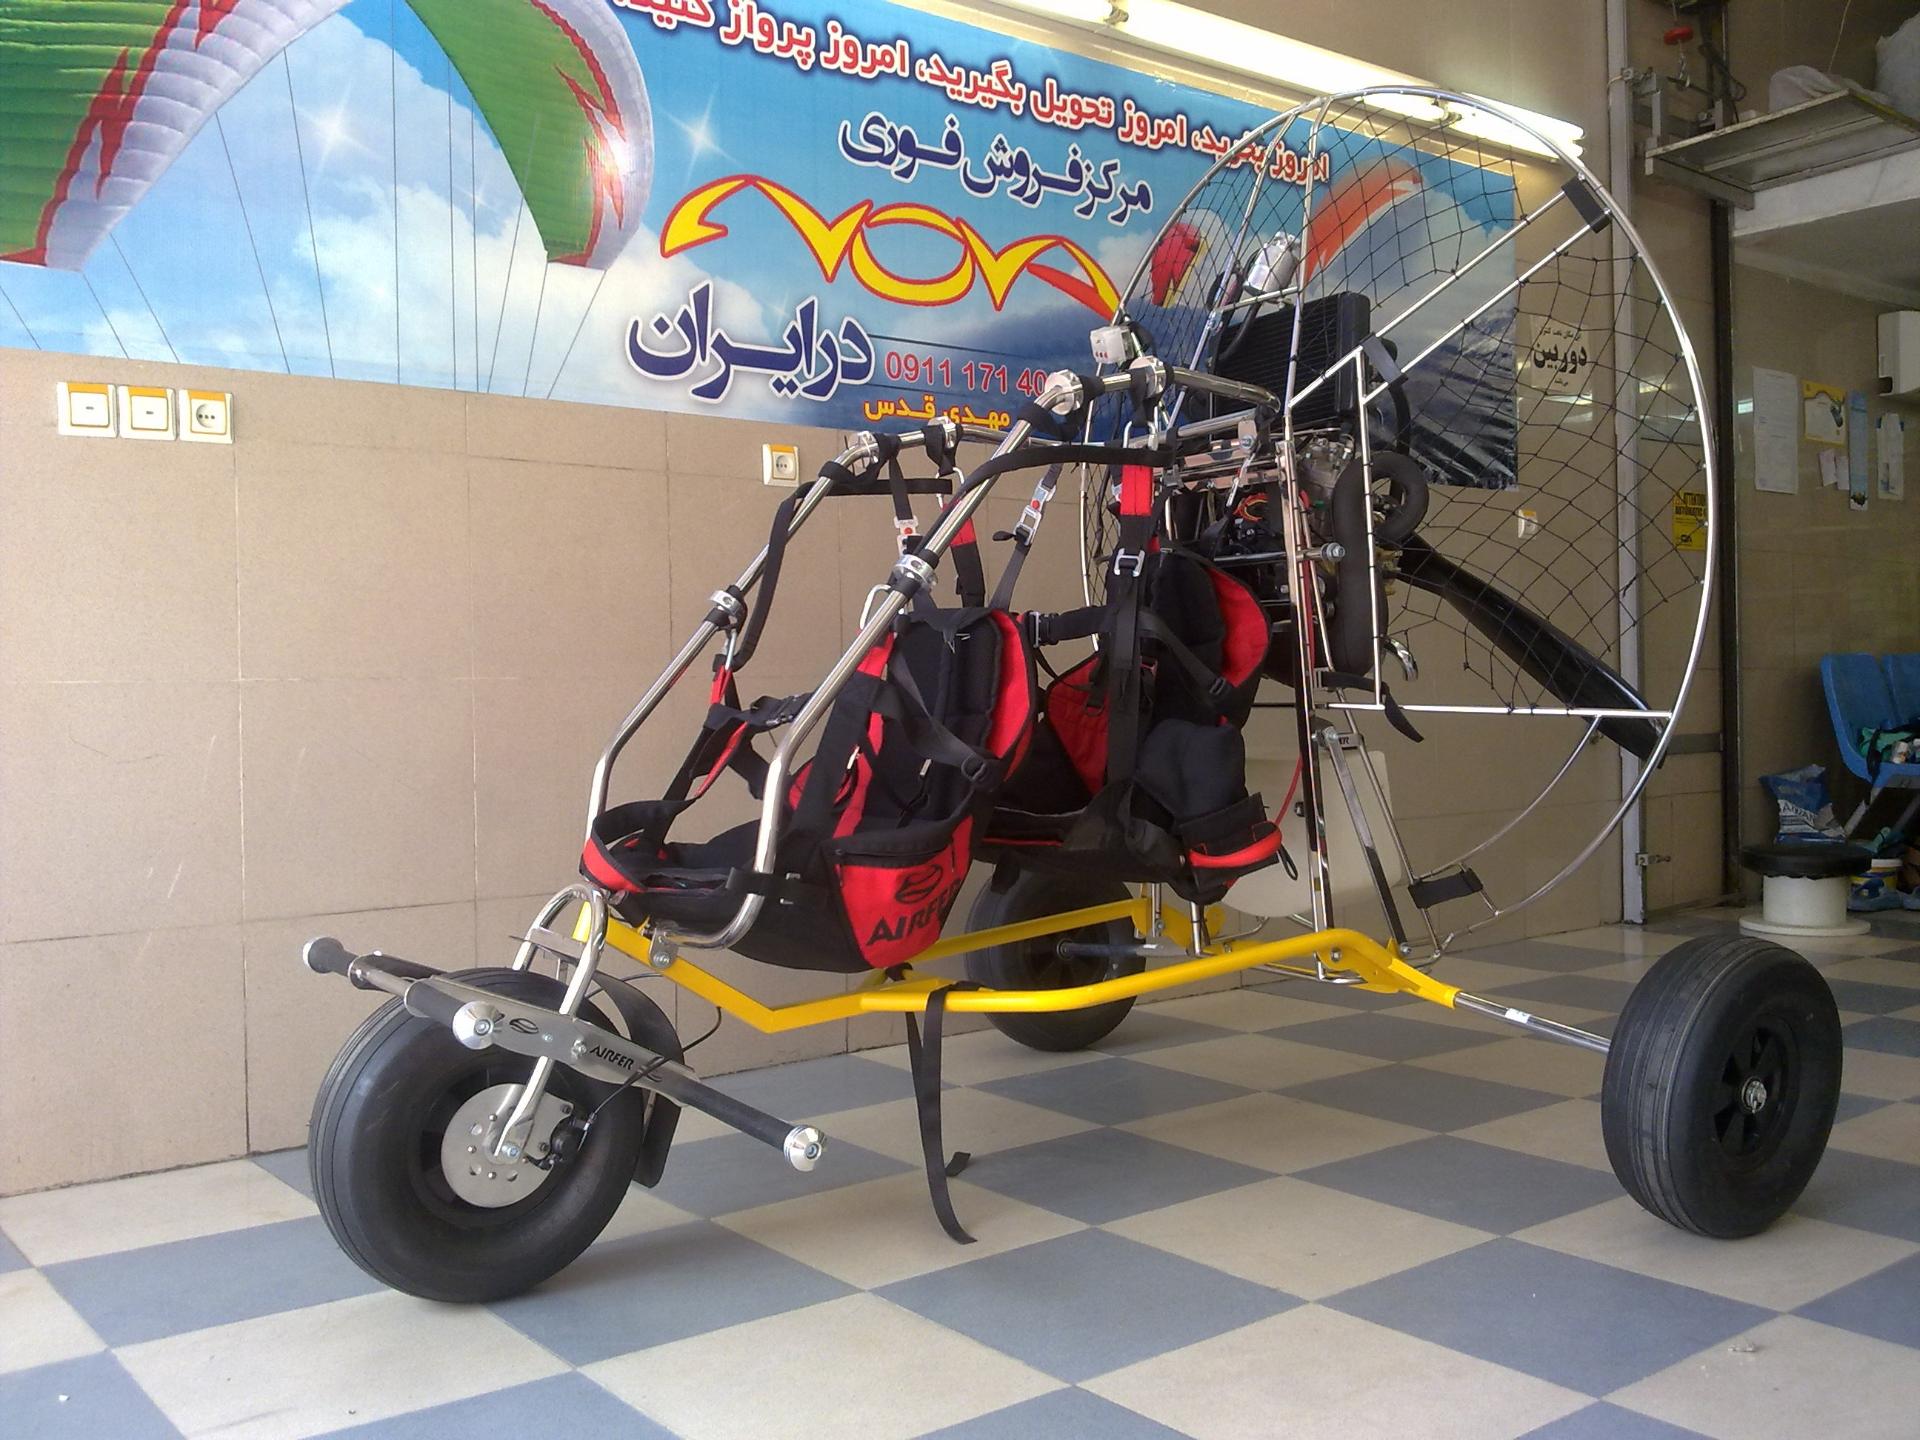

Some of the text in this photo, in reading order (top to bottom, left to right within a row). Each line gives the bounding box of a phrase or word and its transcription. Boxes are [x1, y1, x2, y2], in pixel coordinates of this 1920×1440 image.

[721, 0, 814, 68] پرواز
[822, 24, 908, 76] امروز
[1031, 79, 1114, 127] تحویل
[1118, 101, 1187, 148] امروز
[840, 112, 964, 182] فوری
[885, 351, 951, 387] 0911
[961, 360, 1008, 395] 171
[1533, 342, 1588, 374] دوربین
[864, 394, 937, 422] قدس
[590, 1046, 634, 1070] AIRFER
